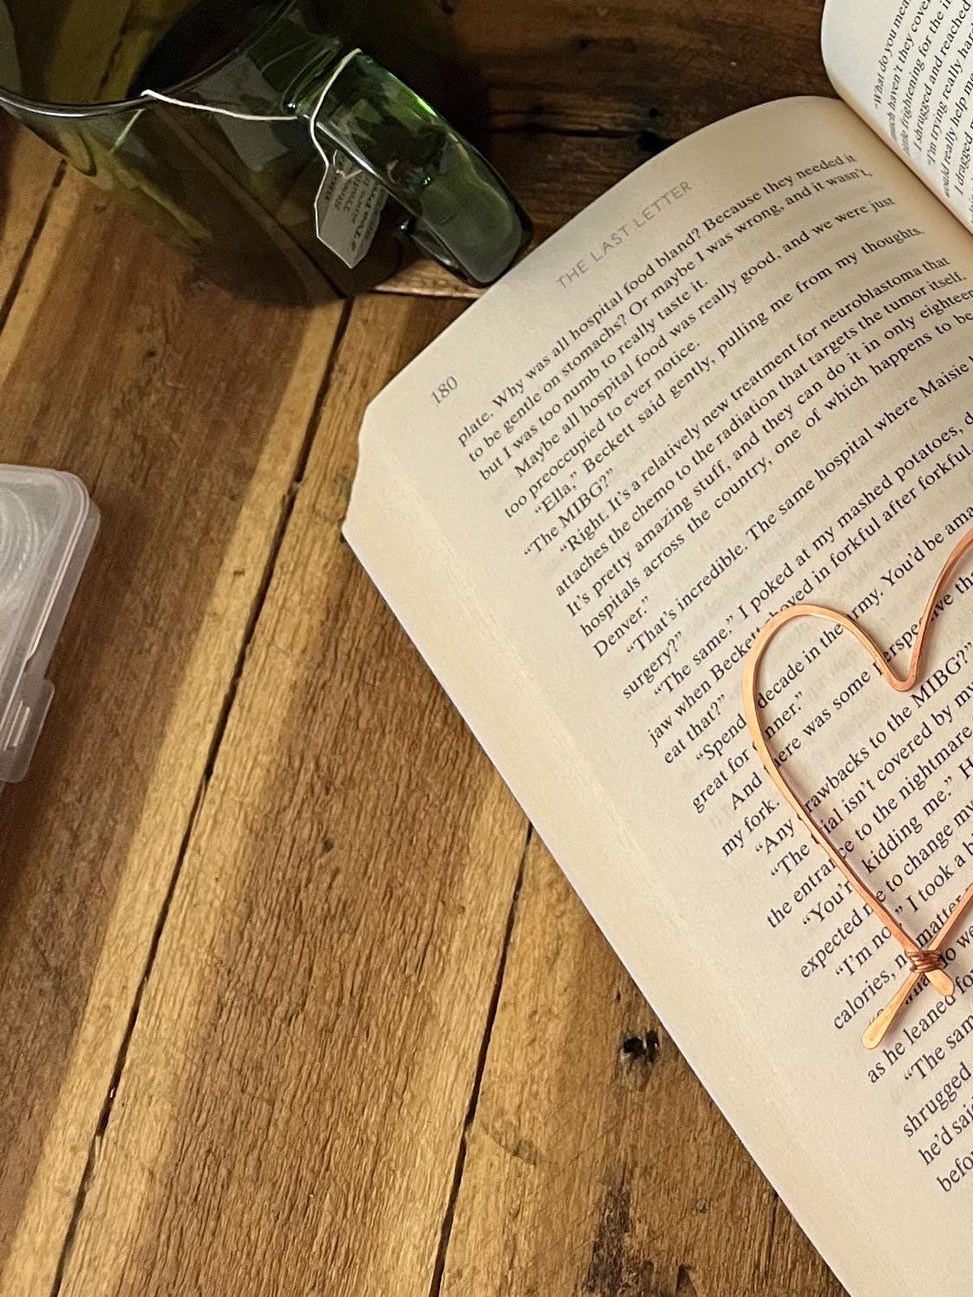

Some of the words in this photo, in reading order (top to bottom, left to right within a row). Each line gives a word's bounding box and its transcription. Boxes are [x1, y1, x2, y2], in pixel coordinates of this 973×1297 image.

[456, 411, 494, 448] plate.
[490, 377, 524, 407] Why
[524, 355, 551, 379] was
[550, 335, 570, 358] all
[567, 289, 624, 341] hospital
[622, 262, 656, 295] food
[653, 226, 702, 268] bland?
[700, 191, 762, 232] Because
[761, 174, 794, 195] they
[794, 154, 845, 179] needed
[513, 432, 561, 478] Maybe
[560, 411, 581, 435] all
[578, 362, 635, 417] hospital
[634, 333, 669, 368] food
[667, 312, 697, 337] was
[697, 278, 737, 315] really
[739, 250, 782, 285] good,
[781, 229, 810, 253] and
[810, 220, 833, 234] we
[833, 205, 869, 223] were
[554, 258, 589, 289] THE
[588, 223, 630, 263] LAST
[631, 180, 693, 228] LETTER
[430, 374, 458, 405] 180
[674, 544, 748, 612] incredible.
[744, 512, 777, 541] The
[777, 478, 816, 516] same
[812, 426, 874, 481] hospital
[872, 395, 919, 431] where
[916, 362, 970, 398] Maisie
[736, 603, 749, 620] I
[749, 561, 794, 614] poked
[794, 547, 812, 567] at
[811, 525, 835, 551] my
[835, 473, 894, 529] mashed
[893, 425, 964, 483] potatoes,
